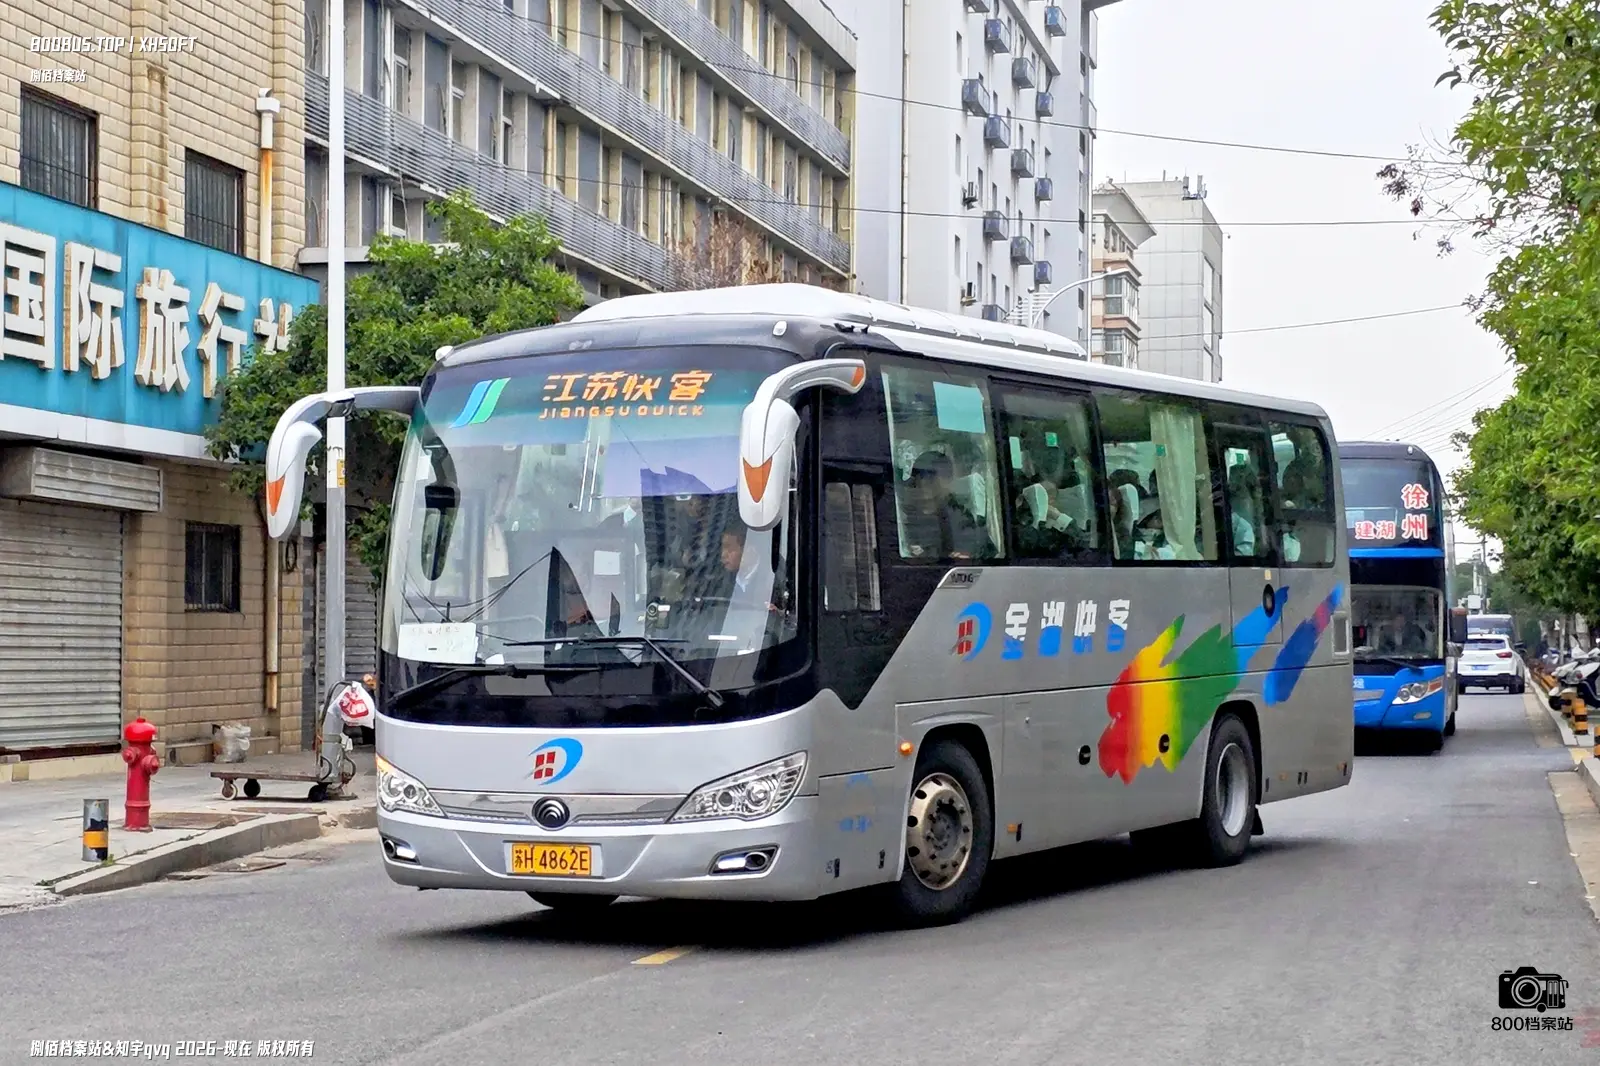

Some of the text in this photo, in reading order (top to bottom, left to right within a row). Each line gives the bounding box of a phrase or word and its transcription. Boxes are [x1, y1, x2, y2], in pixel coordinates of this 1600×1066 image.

[542, 371, 713, 402] 江苏快客
[1401, 483, 1429, 540] 徐州
[1355, 520, 1396, 539] 建湖
